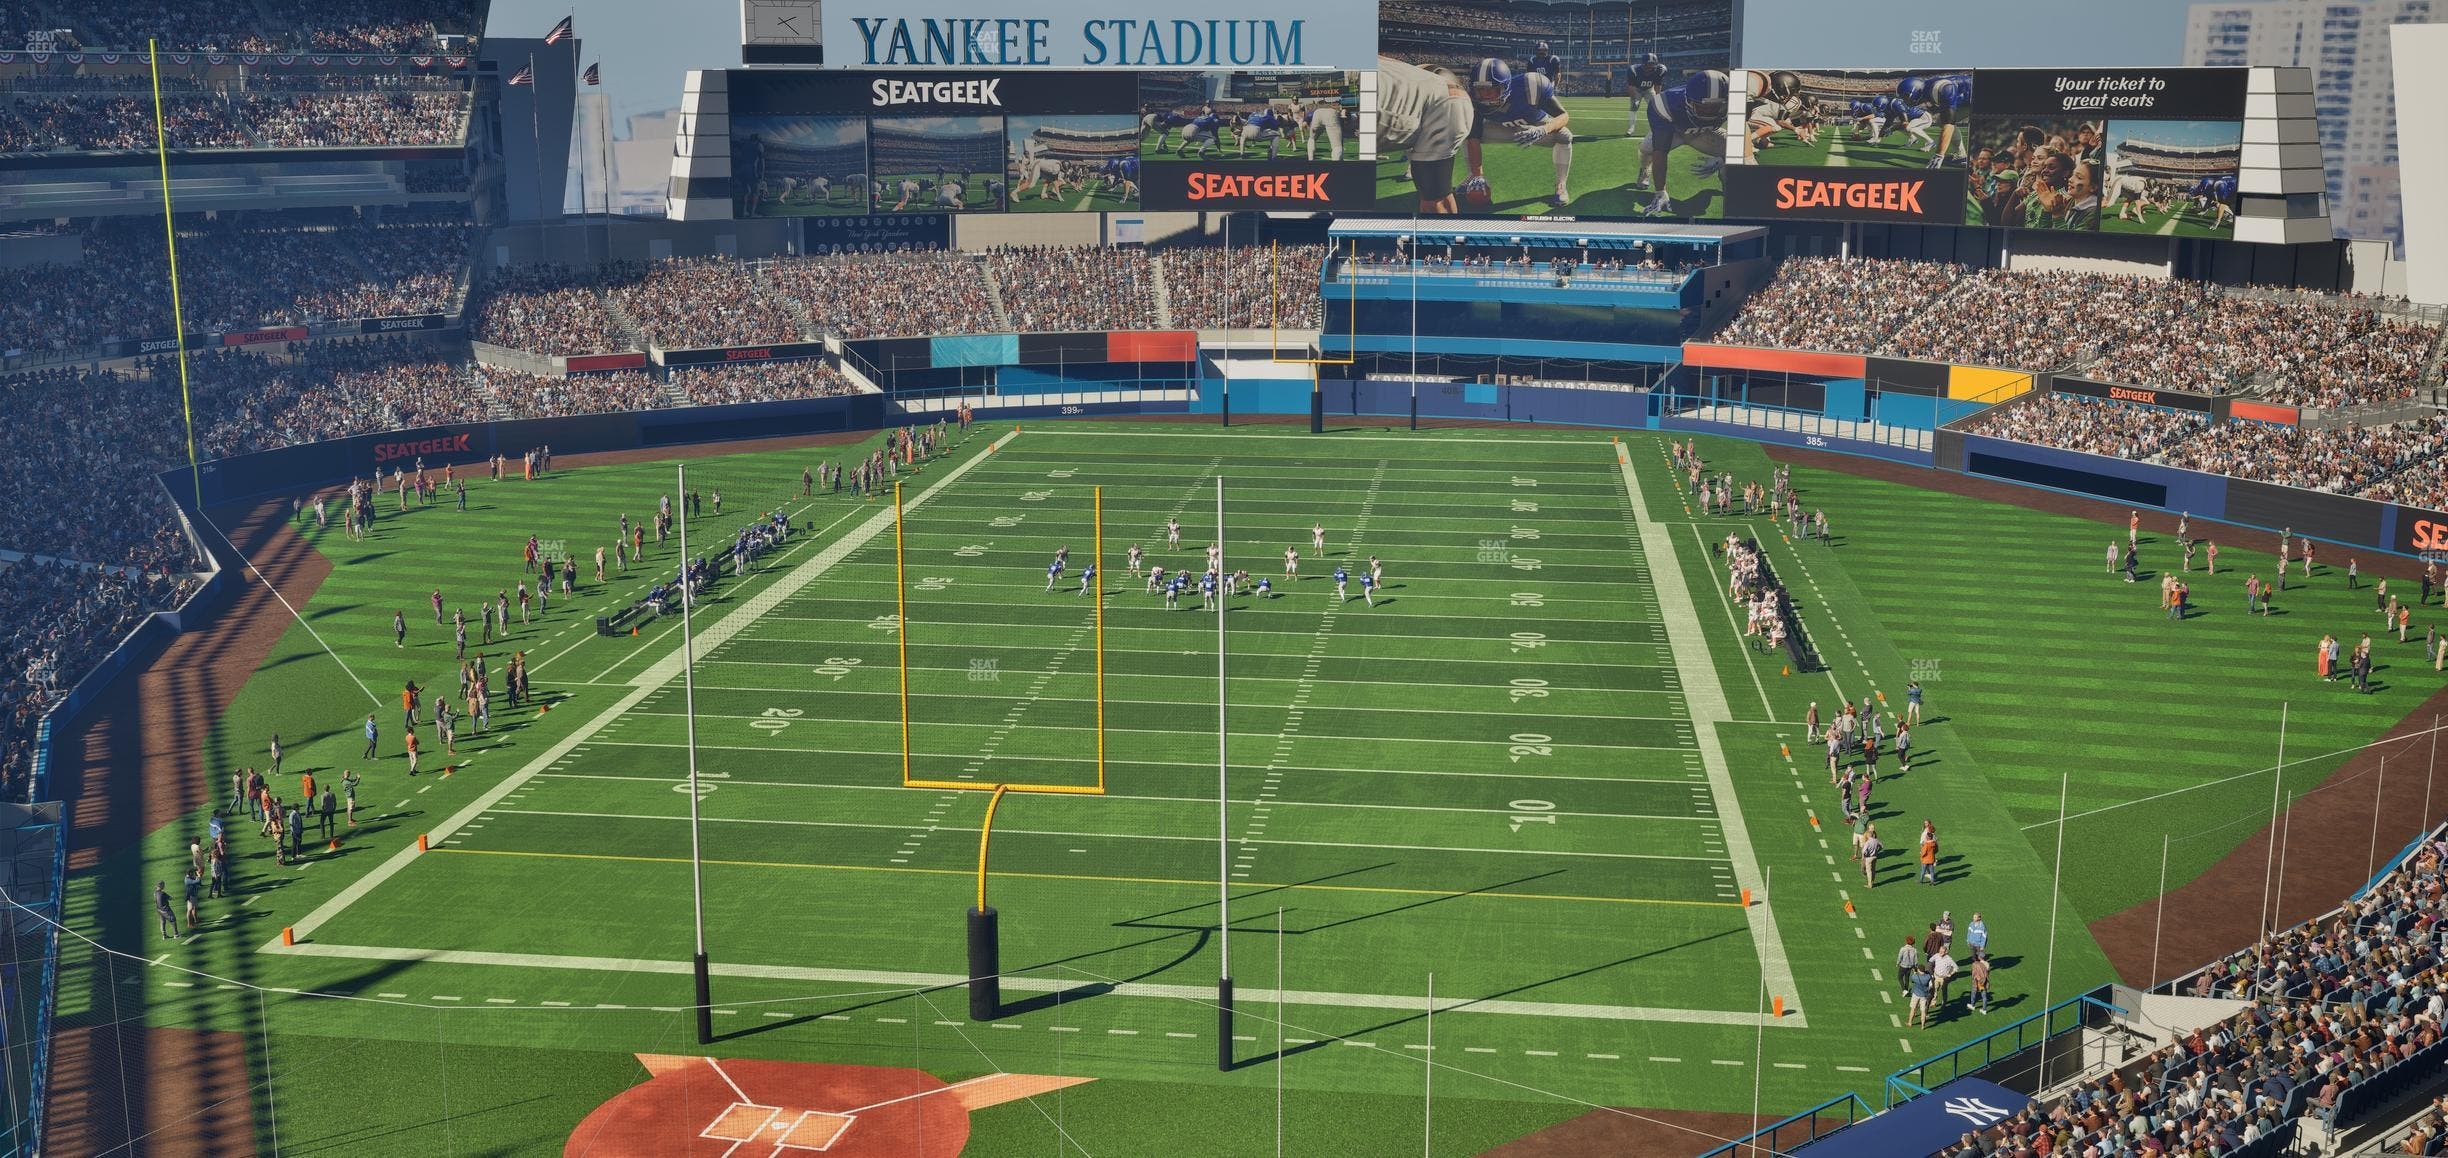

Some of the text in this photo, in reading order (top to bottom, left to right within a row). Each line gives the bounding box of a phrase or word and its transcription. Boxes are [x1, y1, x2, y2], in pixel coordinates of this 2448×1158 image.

[853, 17, 1306, 66] YANKEE STADIUM
[872, 78, 1002, 106] SEATGEEK
[2054, 76, 2166, 92] Your ticket to
[2062, 94, 2155, 110] great seats
[1187, 172, 1330, 201] SEATGEEK
[1776, 177, 1925, 215] SEATGEEK
[380, 317, 425, 330] SEATGEEK
[726, 348, 772, 360] SEATGEEK
[2109, 386, 2156, 404] SEATGEEK
[374, 433, 471, 462] SEATGEEK
[2412, 519, 2448, 551] SE
[1510, 592, 1544, 606] 50
[1510, 632, 1546, 648] 40
[812, 657, 863, 675] 30
[1509, 678, 1549, 698] 30
[749, 707, 805, 729] 20
[1509, 733, 1552, 756] 20
[1508, 799, 1556, 825] 10
